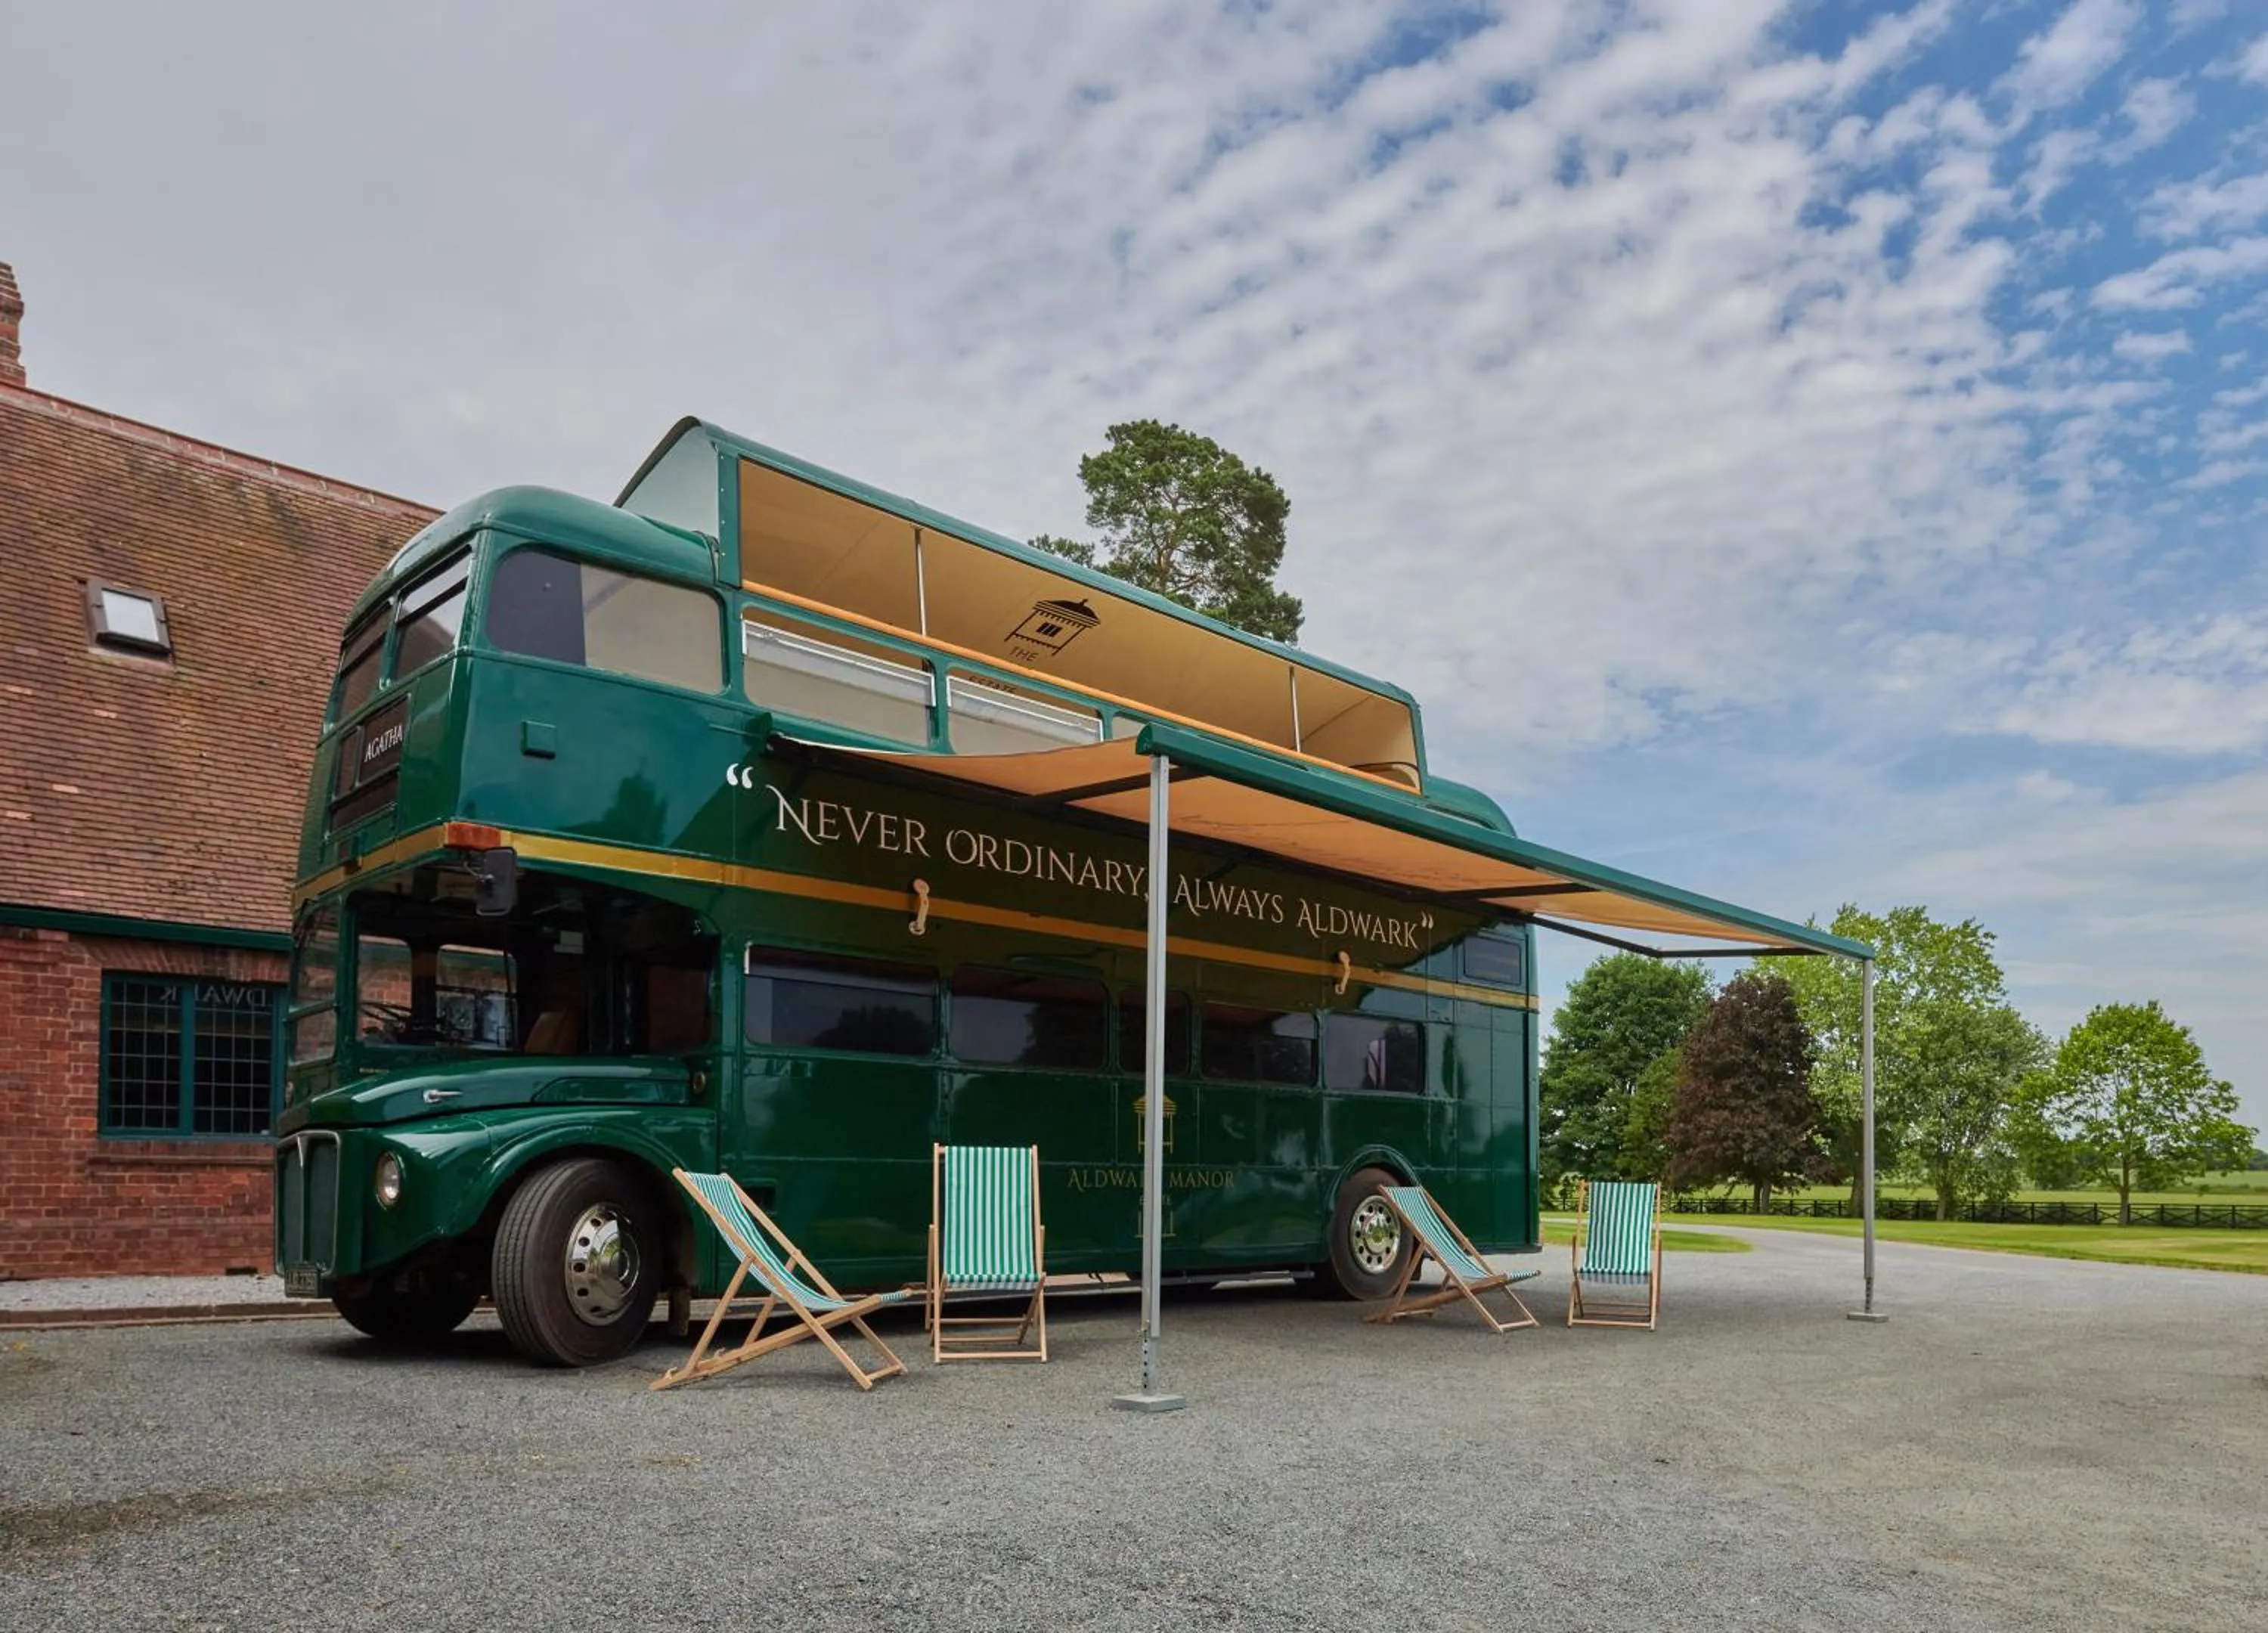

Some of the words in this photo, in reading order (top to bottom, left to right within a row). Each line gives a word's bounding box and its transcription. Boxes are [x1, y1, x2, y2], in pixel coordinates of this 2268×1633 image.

[1009, 646, 1038, 662] THE
[364, 724, 404, 763] AGATHA
[1173, 873, 1284, 924] ALWAYS
[1067, 1168, 1145, 1193] ALDWA
[1169, 1170, 1235, 1189] MANOR
